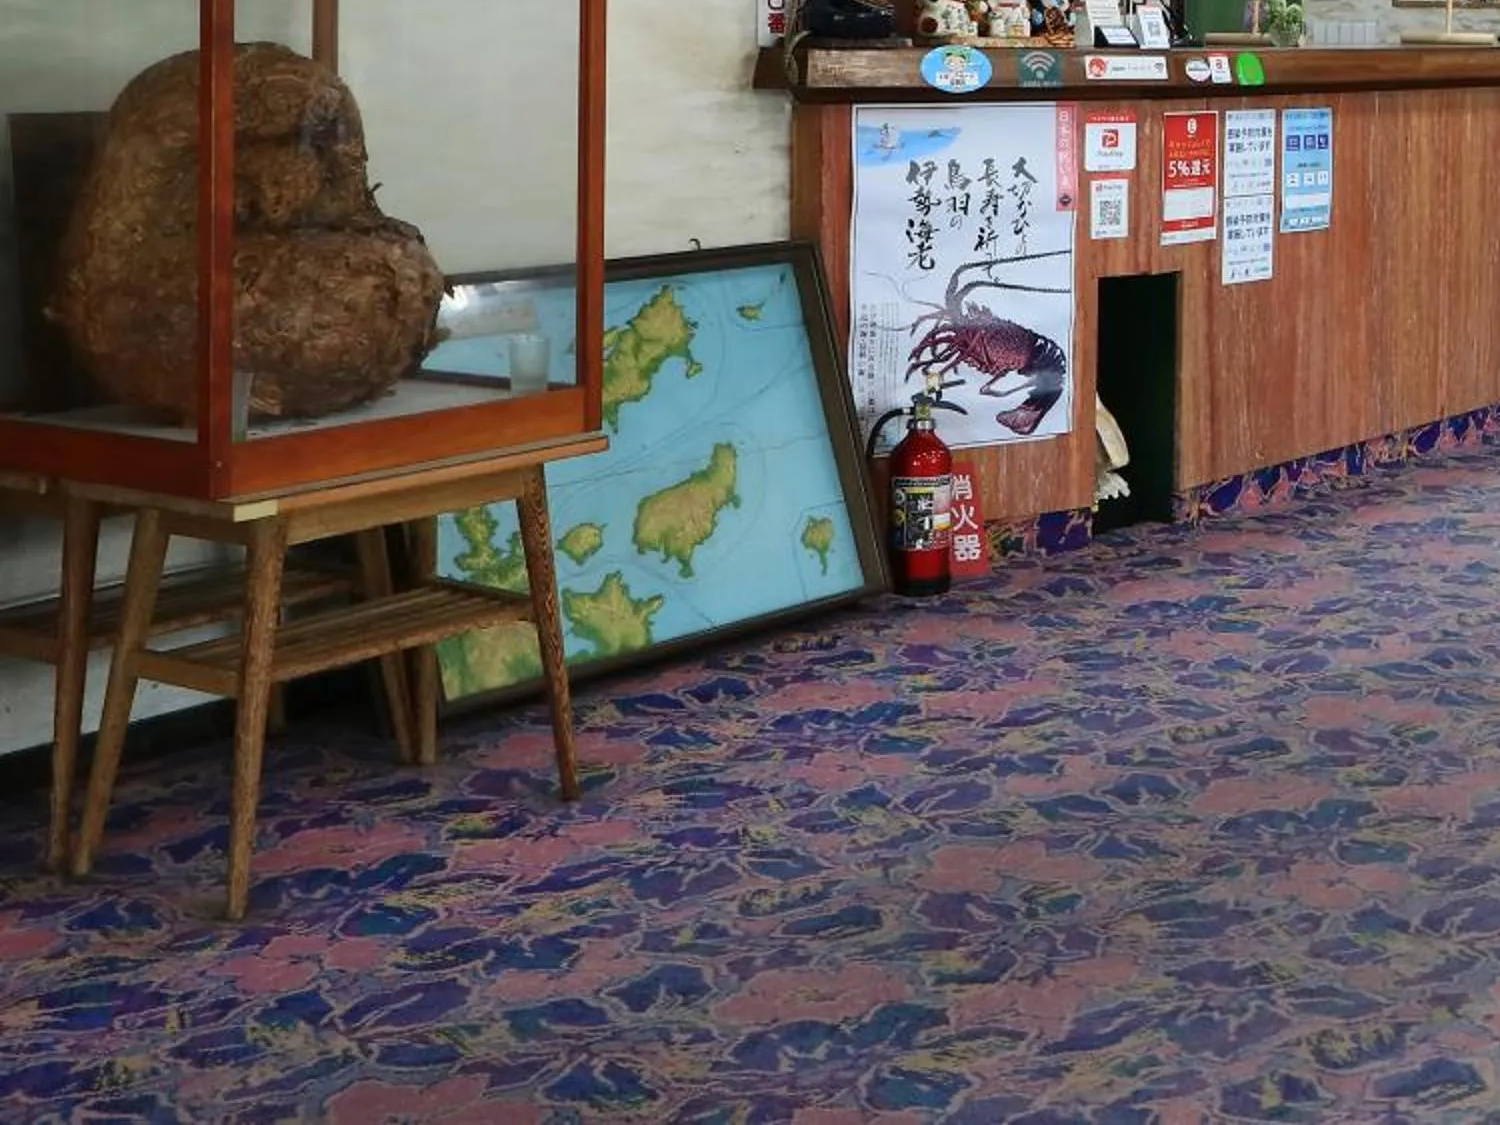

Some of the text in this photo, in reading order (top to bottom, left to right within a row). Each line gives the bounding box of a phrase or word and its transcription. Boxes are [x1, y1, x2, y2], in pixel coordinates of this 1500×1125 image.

[905, 160, 941, 270] 伊勢海老
[944, 158, 972, 230] 鳥羽の
[951, 474, 981, 562] 消火器
